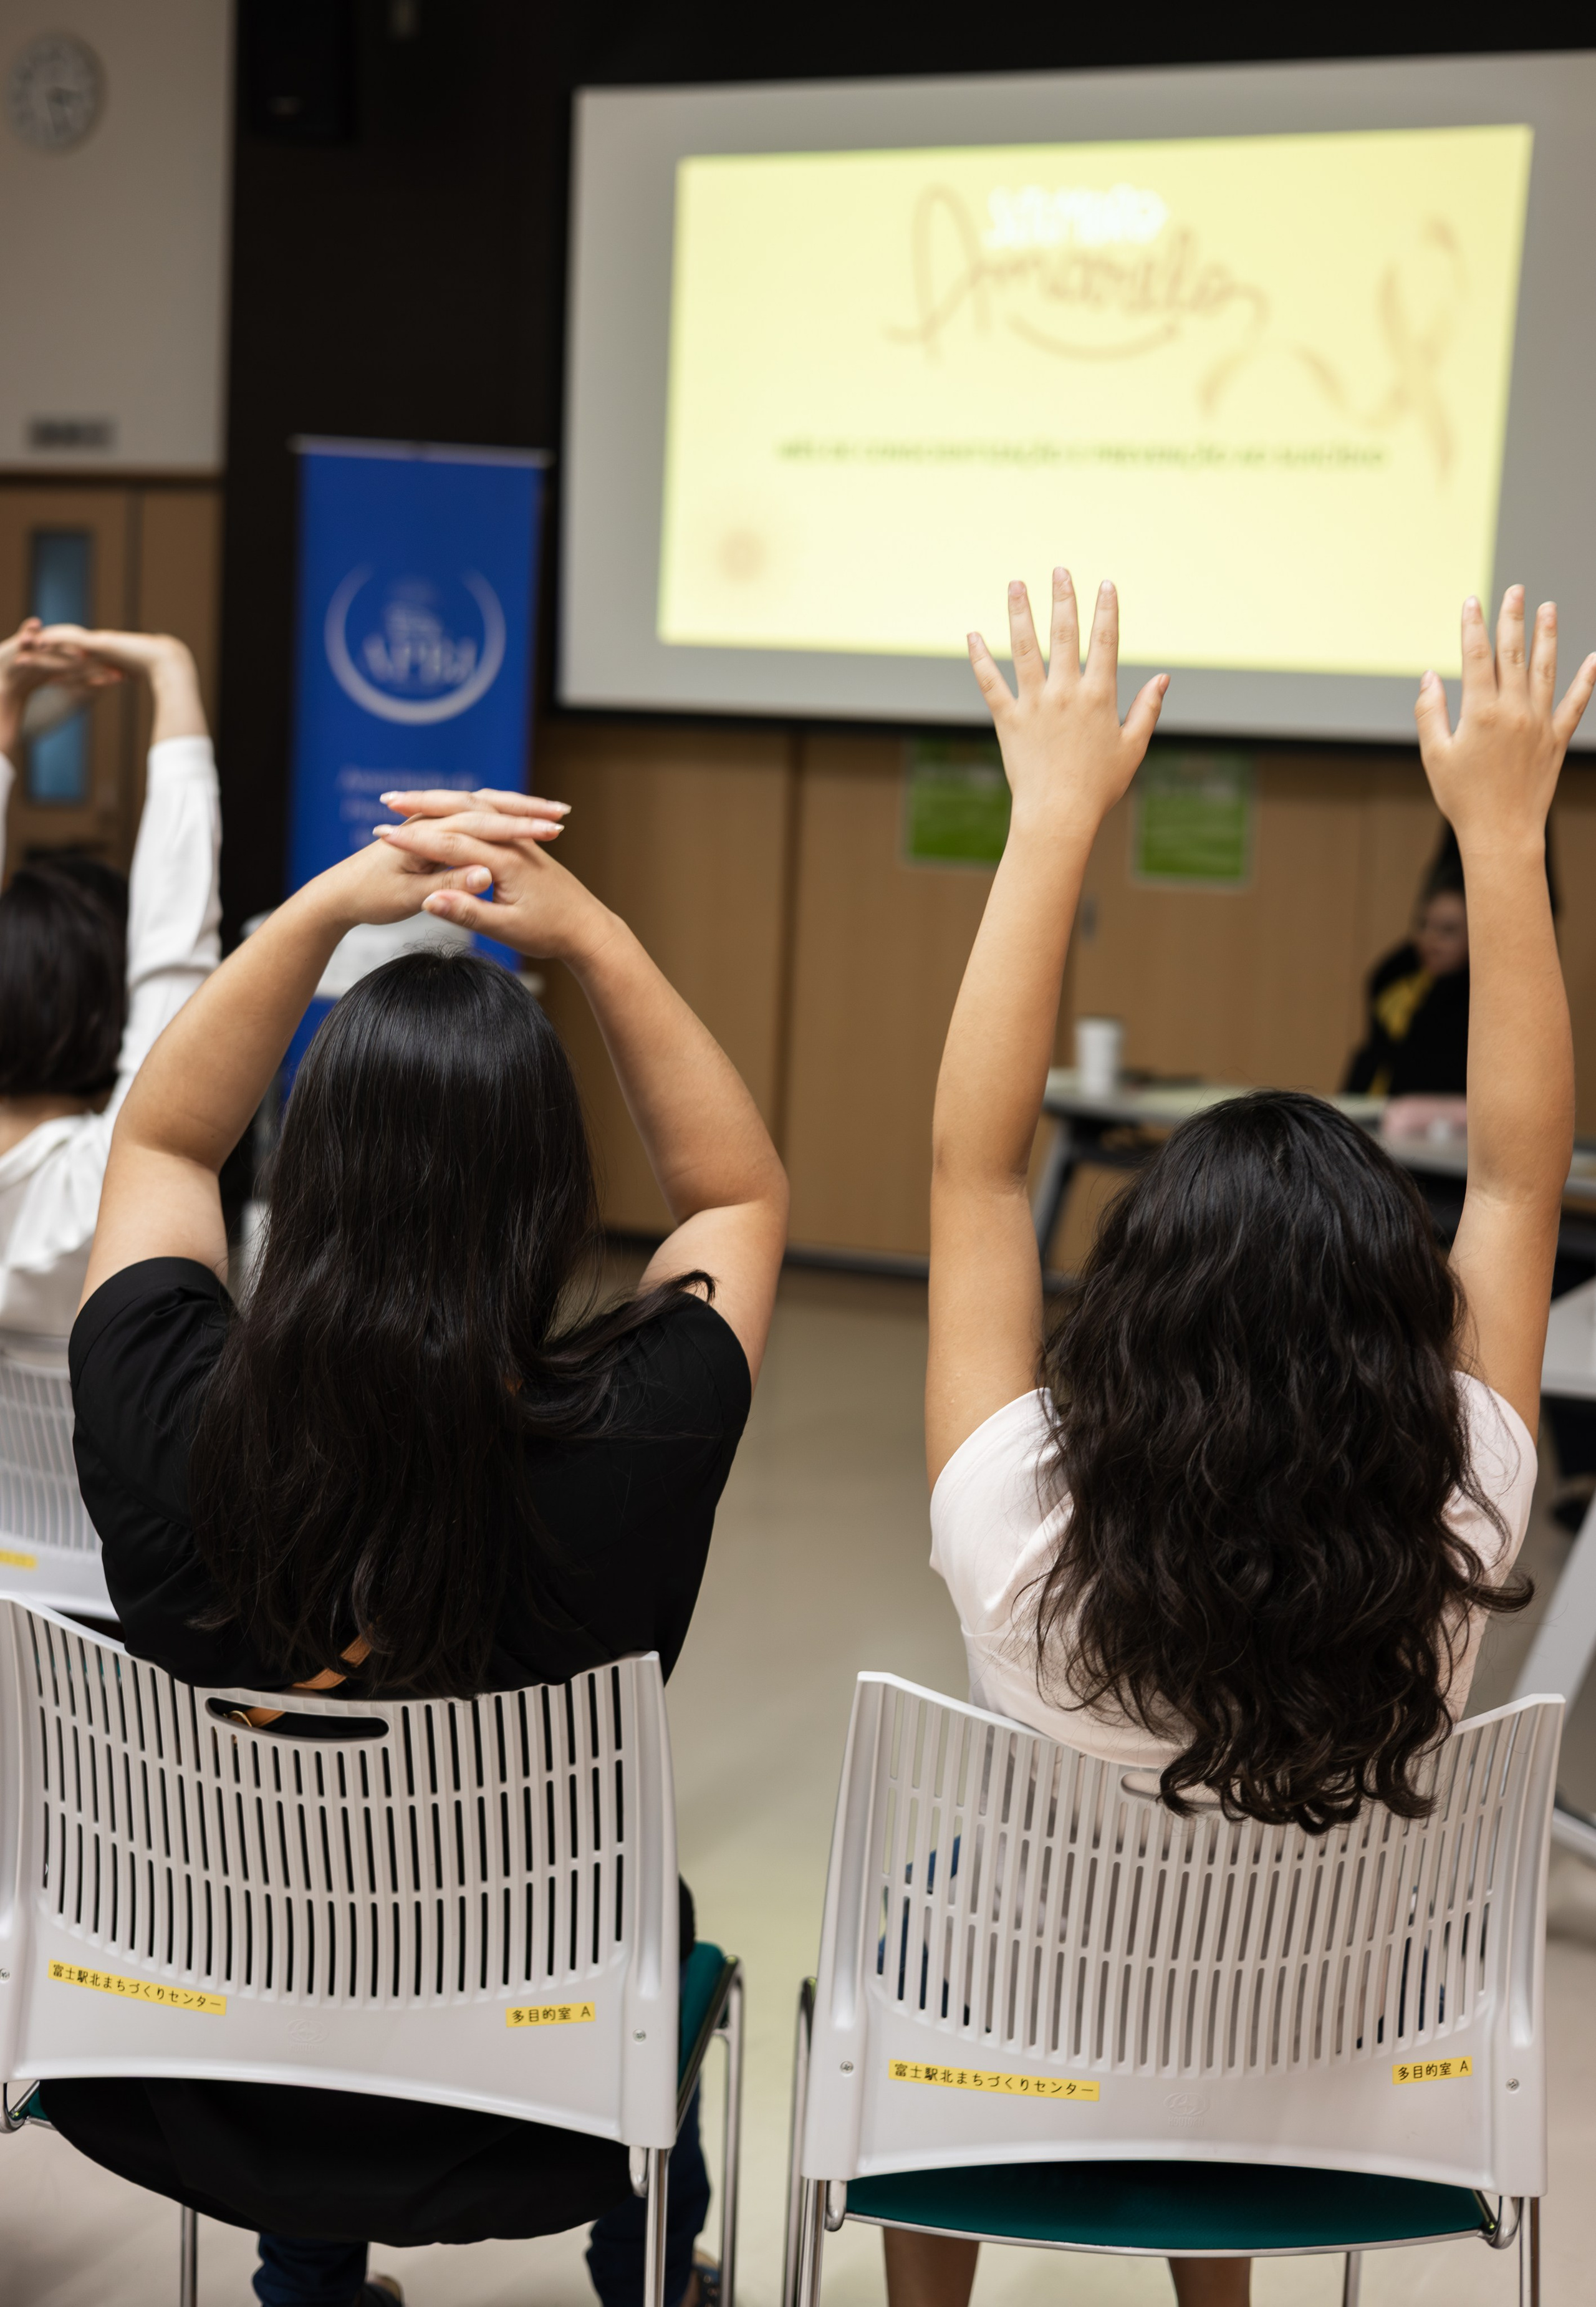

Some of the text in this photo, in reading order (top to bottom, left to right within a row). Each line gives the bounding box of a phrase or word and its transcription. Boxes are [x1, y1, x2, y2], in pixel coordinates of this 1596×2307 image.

[53, 1963, 221, 2007] 富士駅北まちづくりセンター
[512, 2005, 591, 2023] 多目的室 A
[894, 2063, 1094, 2095] 富士駅北まちづくりセンター
[1398, 2059, 1469, 2081] 多目的室 A
